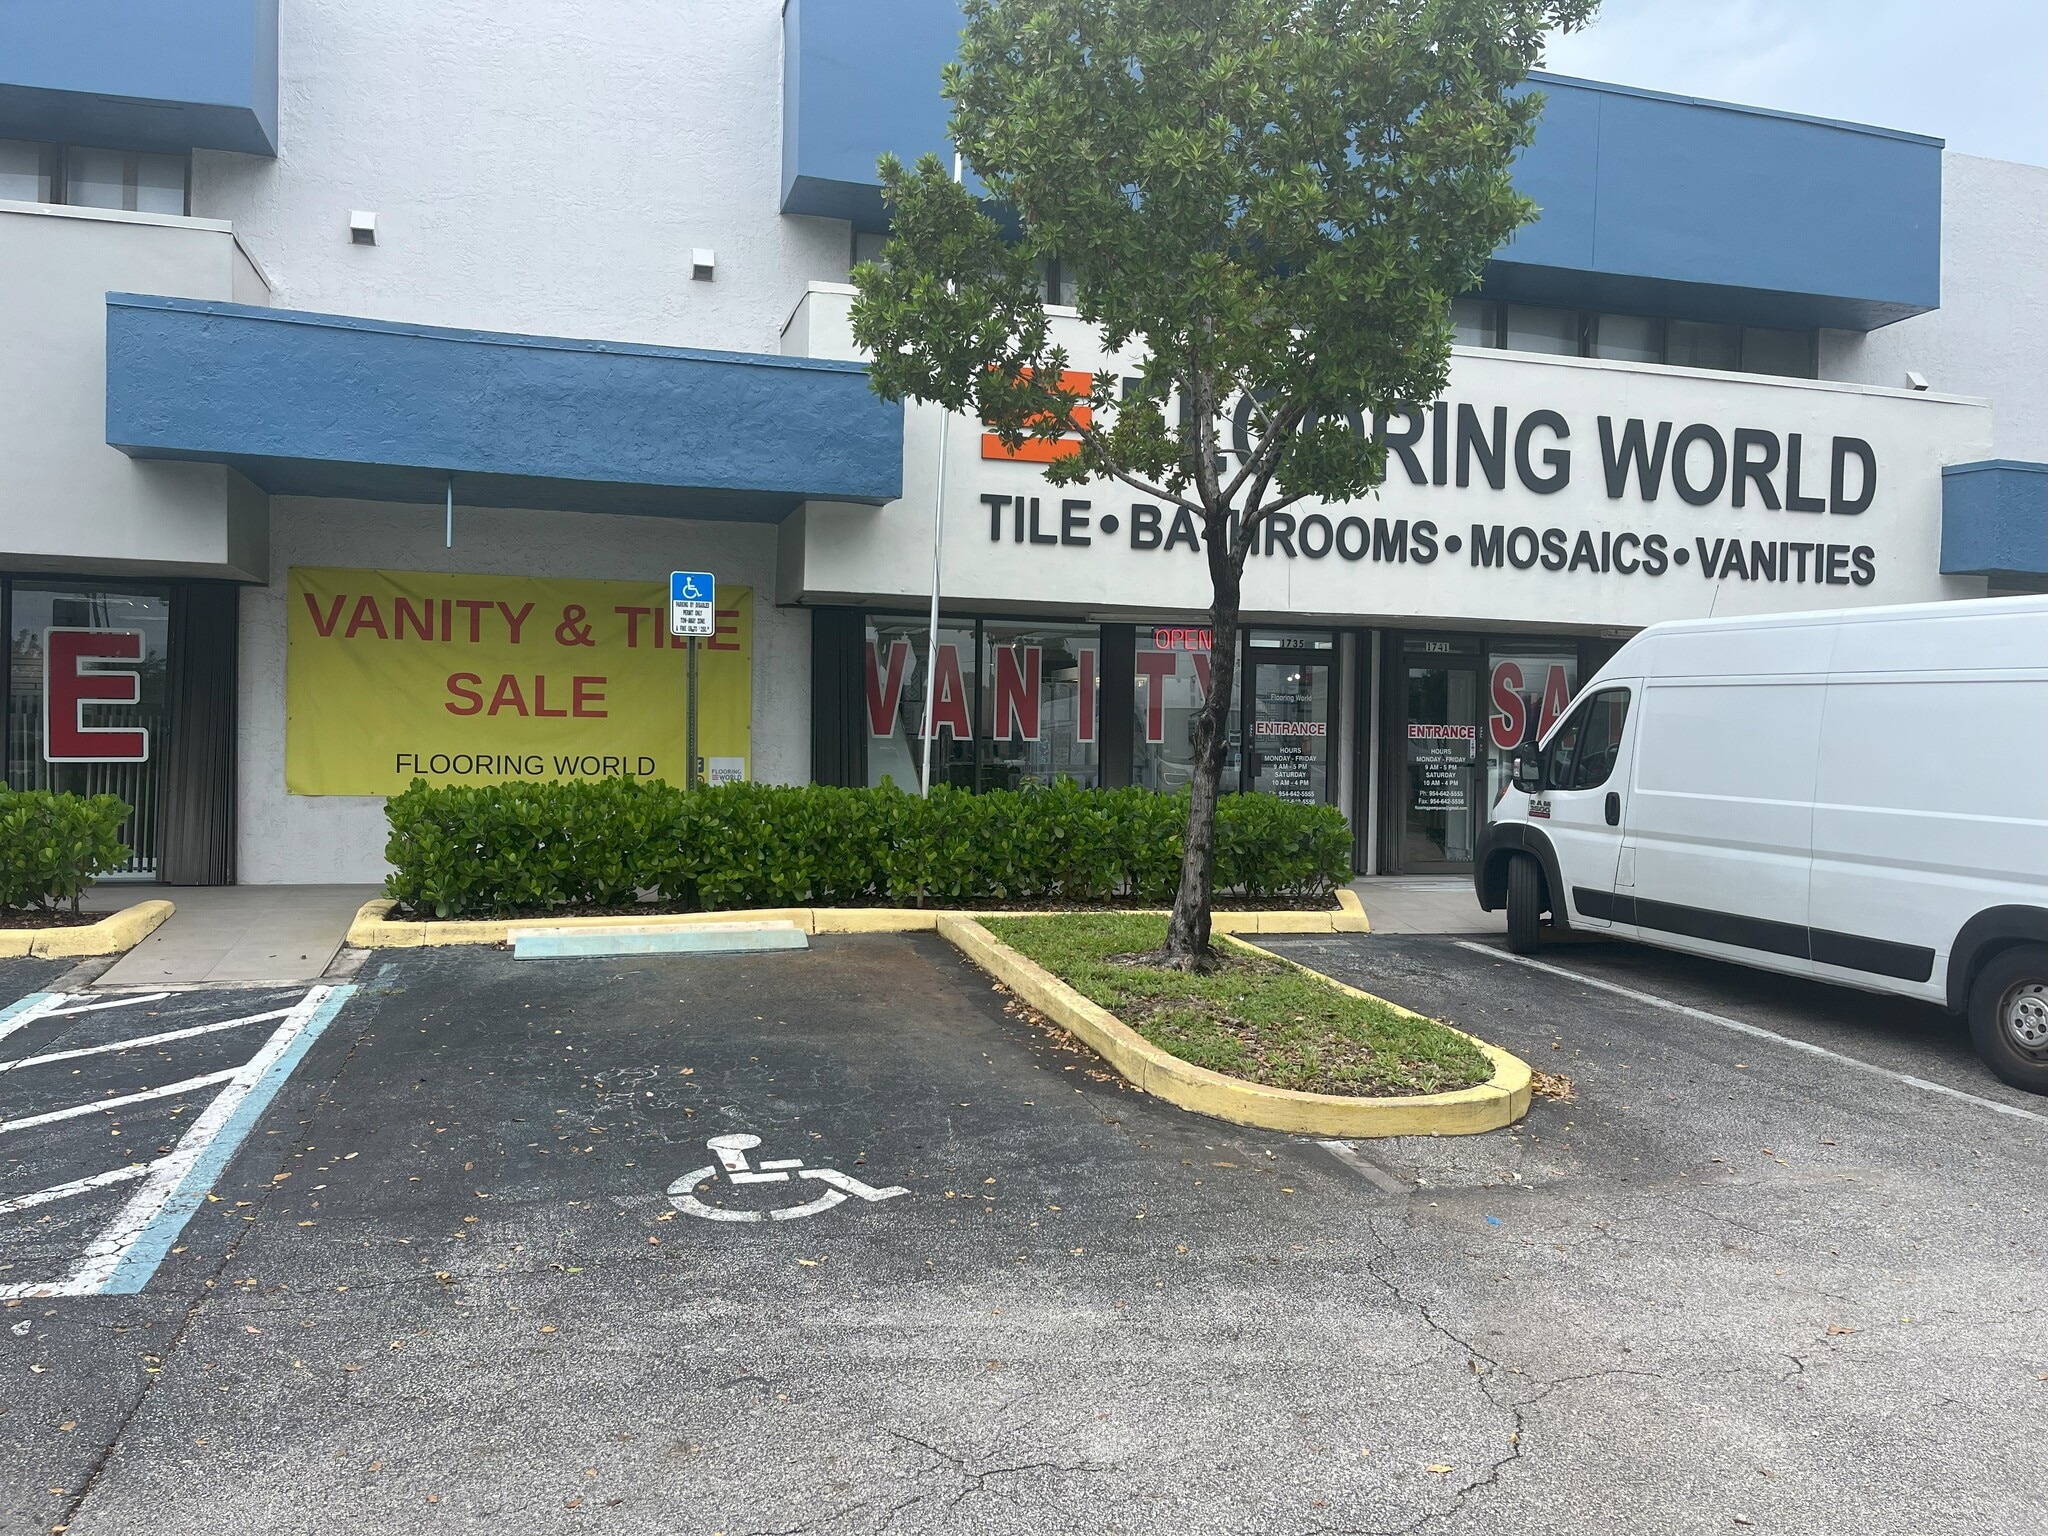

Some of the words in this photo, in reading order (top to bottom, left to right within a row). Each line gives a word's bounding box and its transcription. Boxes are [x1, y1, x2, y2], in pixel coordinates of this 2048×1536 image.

[1597, 415, 1877, 515] WORLD
[980, 493, 1091, 546] TILE
[1130, 503, 1439, 564] BAHROOMS
[1470, 524, 1669, 576] MOSAICS
[1695, 536, 1876, 586] VANITIES
[303, 592, 536, 645] VANITY
[554, 604, 596, 648] &
[614, 606, 741, 651] TIE
[1155, 628, 1213, 650] OPEN
[1281, 638, 1304, 648] 1735
[1427, 642, 1449, 652] 1741
[44, 626, 149, 763] E
[444, 672, 609, 718] SALE
[1270, 693, 1294, 702] Flooring
[1295, 694, 1312, 702] World
[1256, 722, 1326, 735] ENTRANCE
[1408, 725, 1475, 738] ENTRANCE
[395, 752, 544, 776] FLOORING
[553, 755, 656, 777] WORLD
[1530, 799, 1552, 807] RAM
